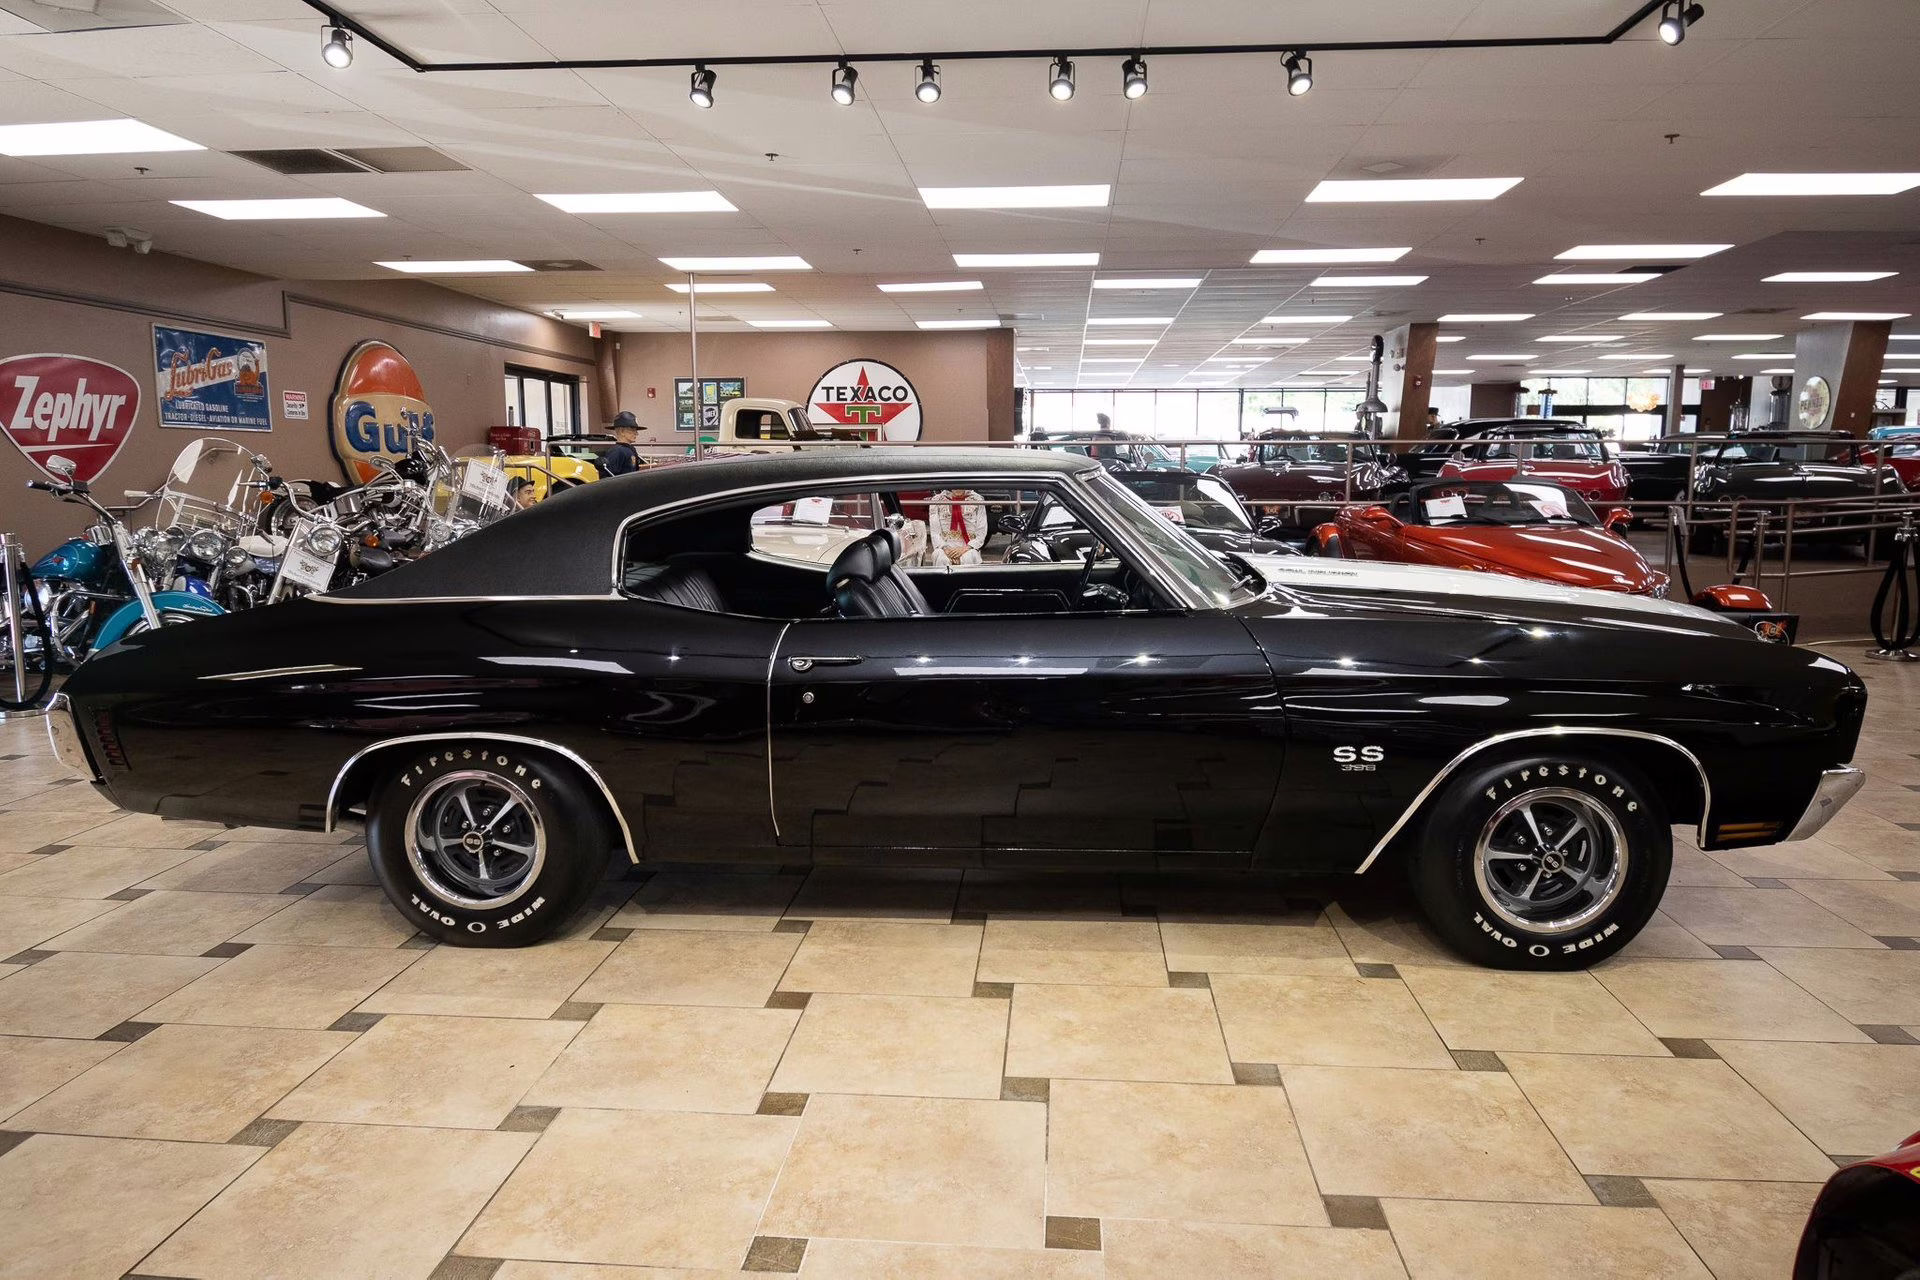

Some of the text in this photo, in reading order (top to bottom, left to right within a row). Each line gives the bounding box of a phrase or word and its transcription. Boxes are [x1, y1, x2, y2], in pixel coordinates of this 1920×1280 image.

[9, 375, 127, 442] Zephyr
[205, 403, 229, 413] GASOLINE
[821, 385, 908, 402] TEXACO
[165, 412, 188, 421] TRACTOR
[190, 413, 207, 422] DIESEL
[209, 415, 231, 424] AVIATION
[238, 417, 257, 425] MARINE
[401, 749, 541, 789] Firestone
[1333, 745, 1384, 762] SS
[1485, 764, 1638, 812] Firestone
[411, 894, 456, 926] OVAL
[497, 896, 546, 929] WIDE
[1473, 912, 1518, 948] OVAL
[1562, 923, 1620, 954] WIDE
